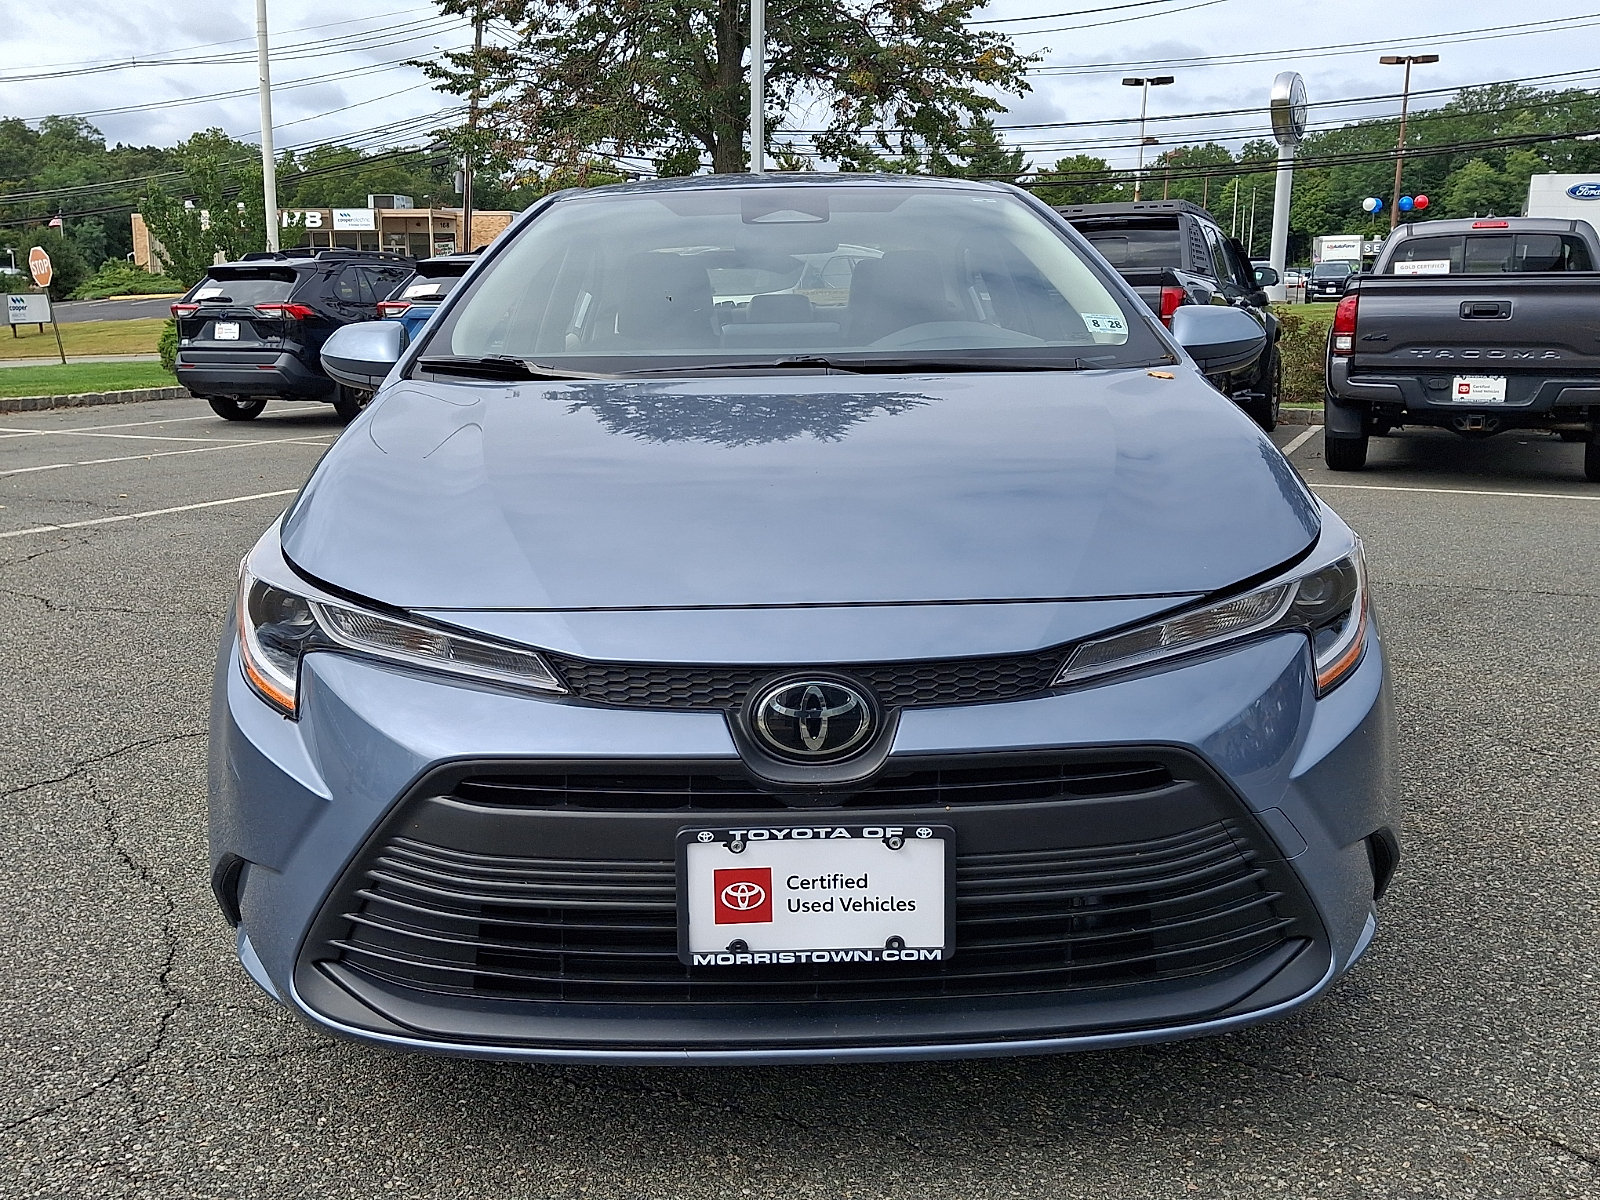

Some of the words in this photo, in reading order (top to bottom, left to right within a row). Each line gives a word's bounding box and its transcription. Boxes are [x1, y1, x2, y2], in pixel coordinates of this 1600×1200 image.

[32, 259, 48, 275] STOP
[1091, 319, 1100, 328] 8
[1107, 320, 1122, 328] 28
[1410, 349, 1561, 359] TACOMA
[728, 827, 852, 841] TOYOTA
[862, 826, 904, 839] OF
[786, 873, 868, 890] Certified
[787, 898, 834, 913] Used
[839, 896, 917, 913] Vehicles
[693, 949, 942, 966] MORRISTOWN.COM
